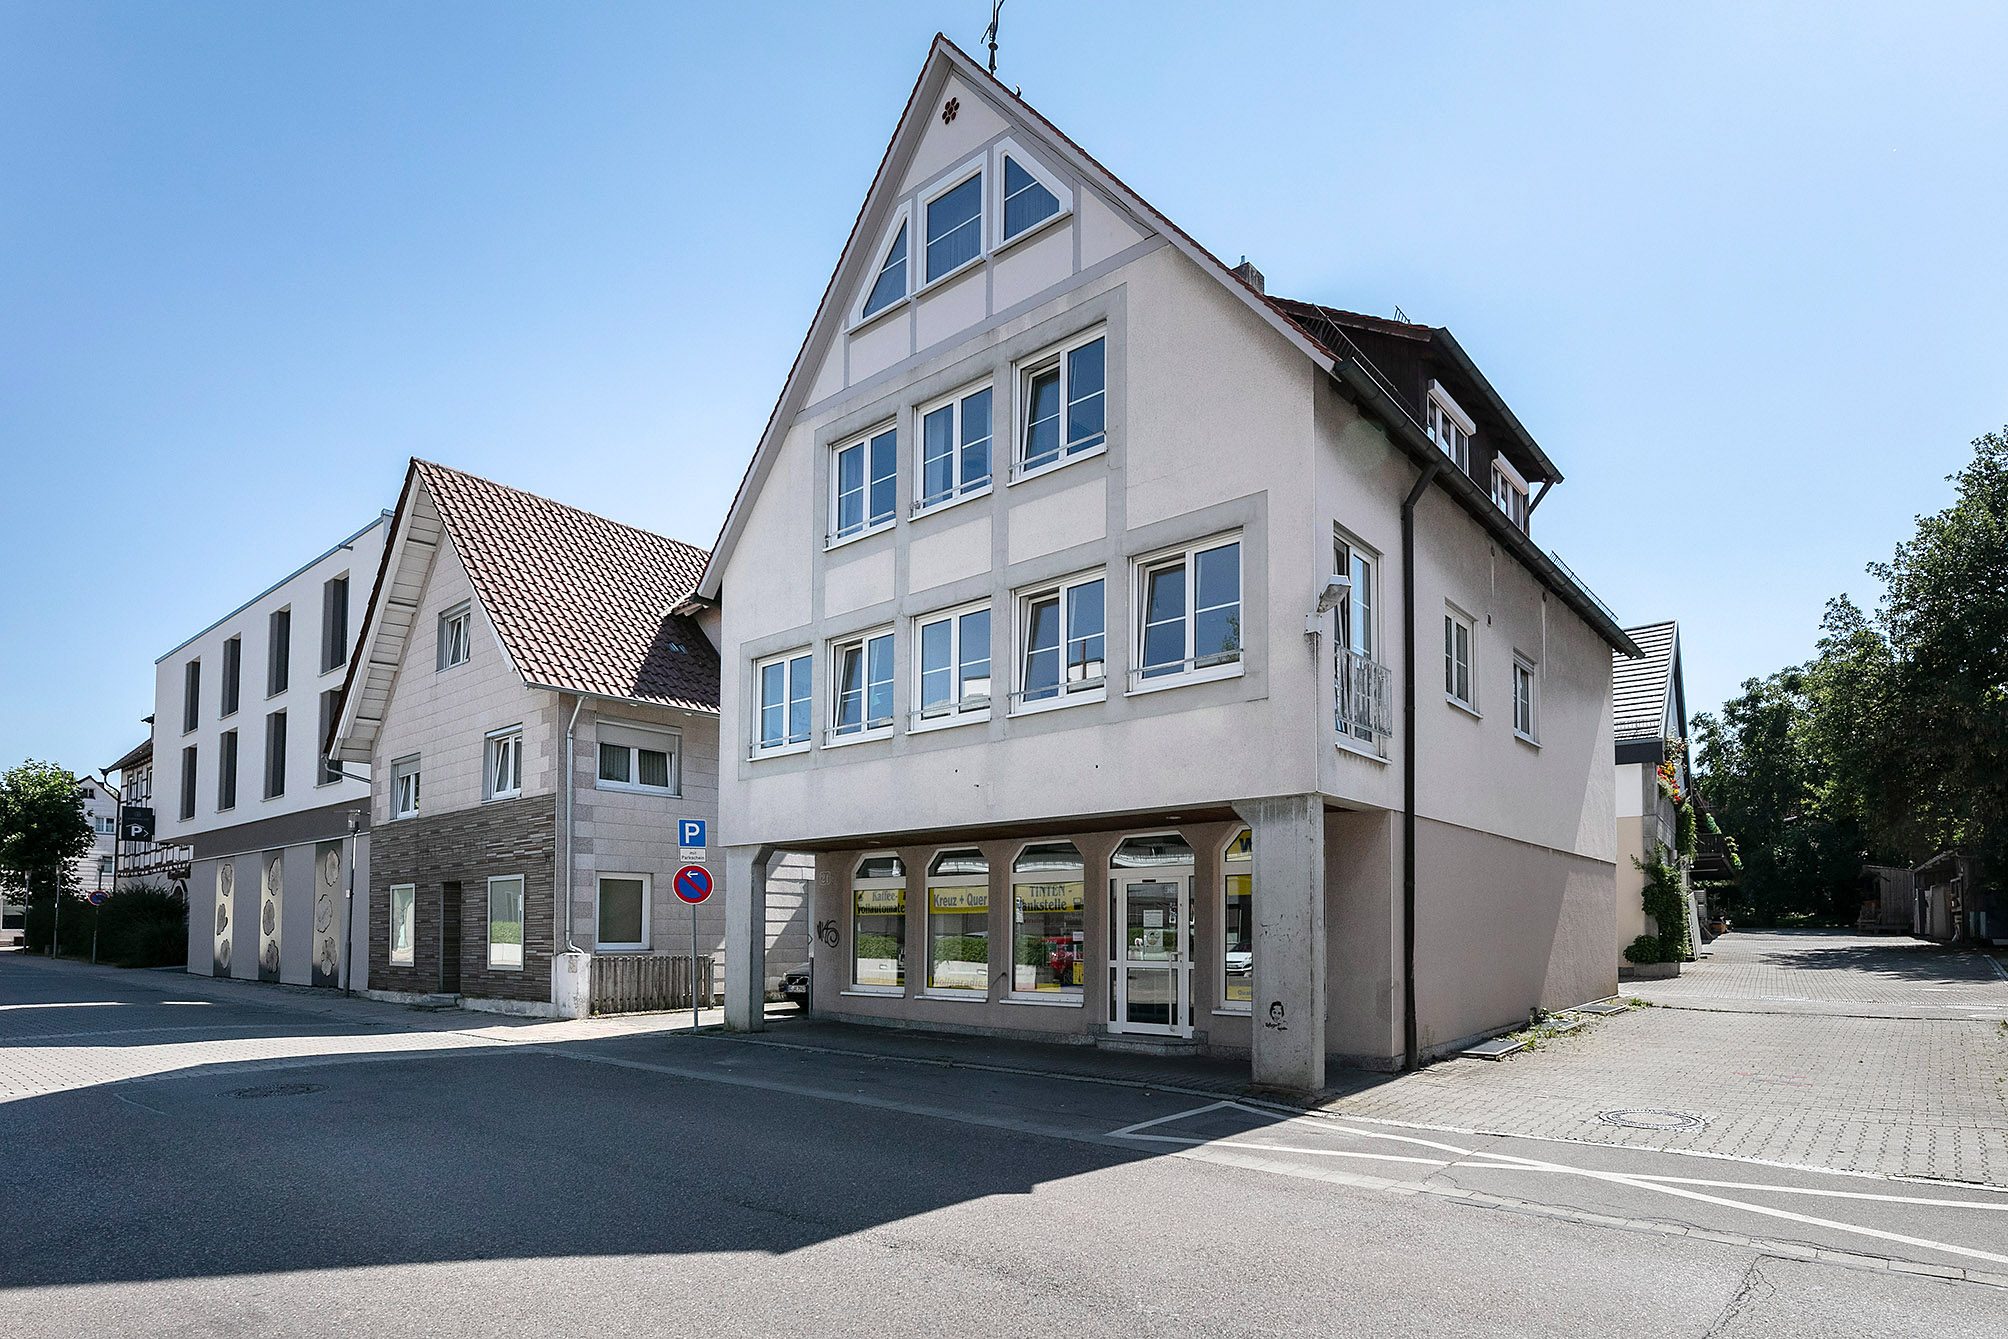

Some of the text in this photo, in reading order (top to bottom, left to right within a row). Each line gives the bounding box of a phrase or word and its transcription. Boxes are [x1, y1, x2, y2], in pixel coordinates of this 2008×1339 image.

[131, 825, 143, 837] P
[685, 822, 700, 844] P
[1029, 886, 1065, 897] TINTEN
[934, 894, 957, 907] Kreuz
[967, 893, 988, 906] Quer
[1019, 899, 1067, 911] ankstelle
